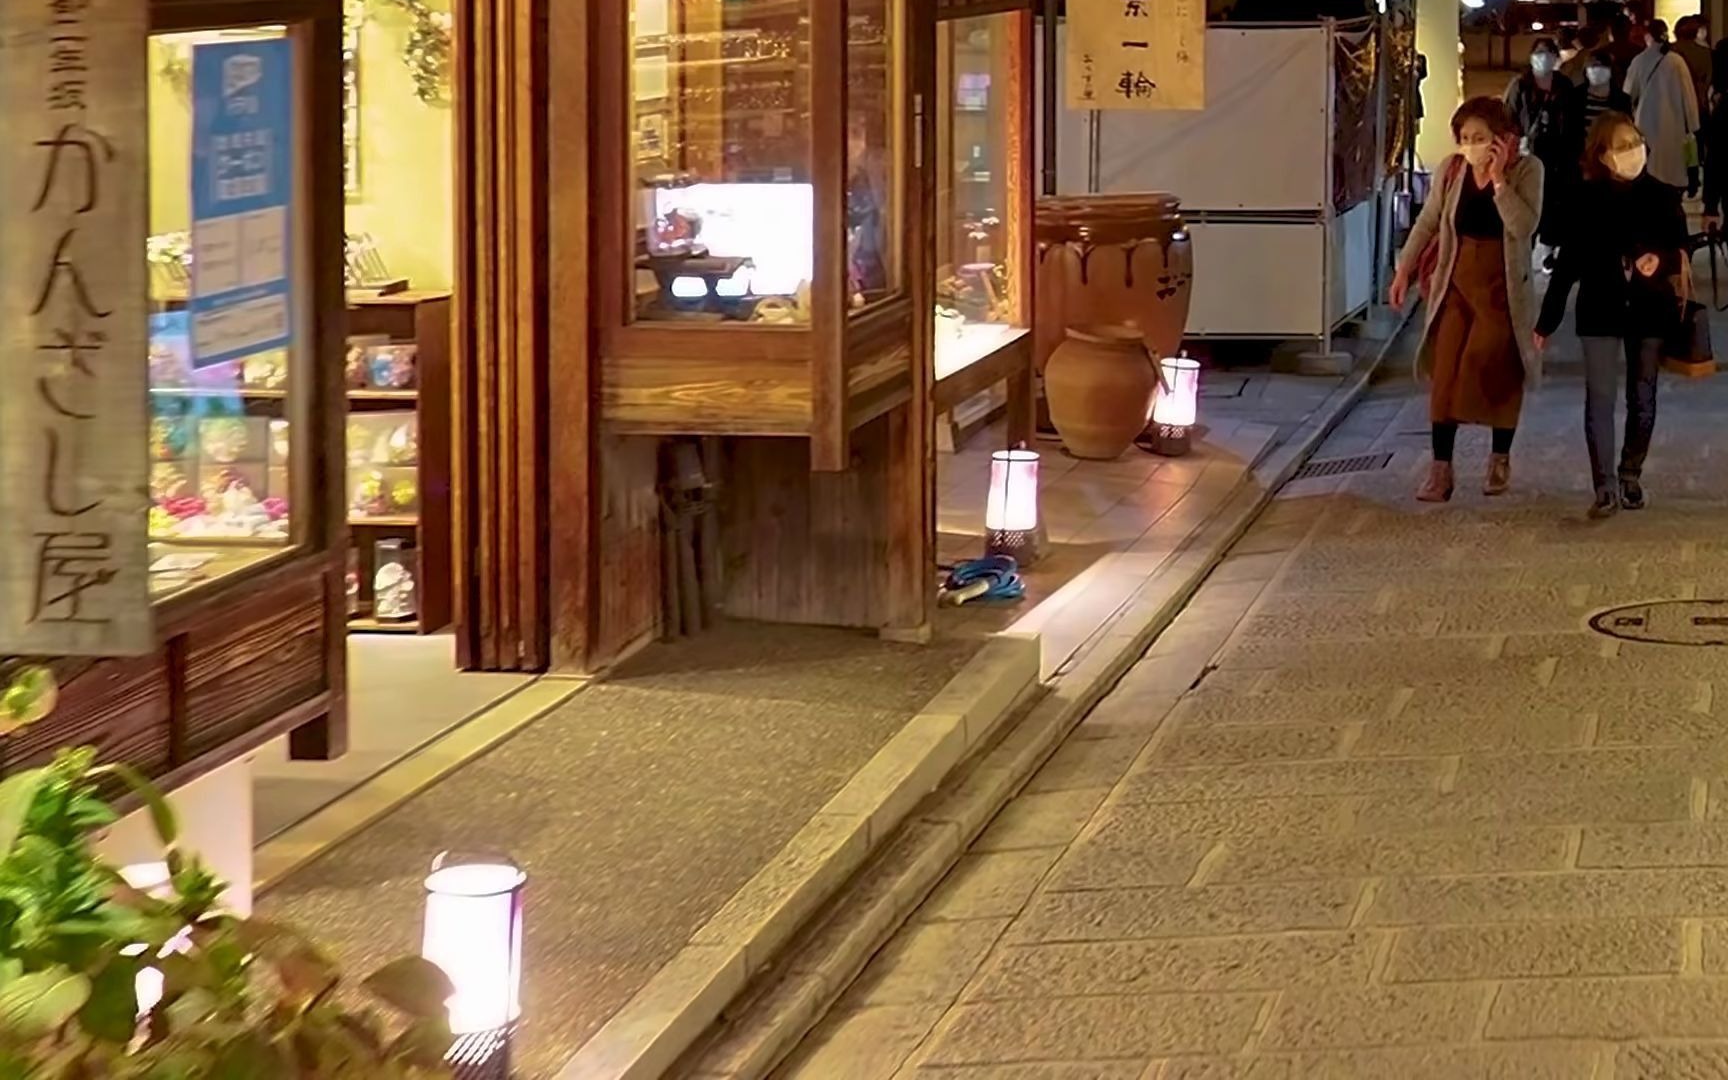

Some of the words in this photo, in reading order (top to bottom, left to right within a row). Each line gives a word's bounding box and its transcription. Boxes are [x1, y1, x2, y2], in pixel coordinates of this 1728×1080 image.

[27, 122, 121, 623] かんざし屋
